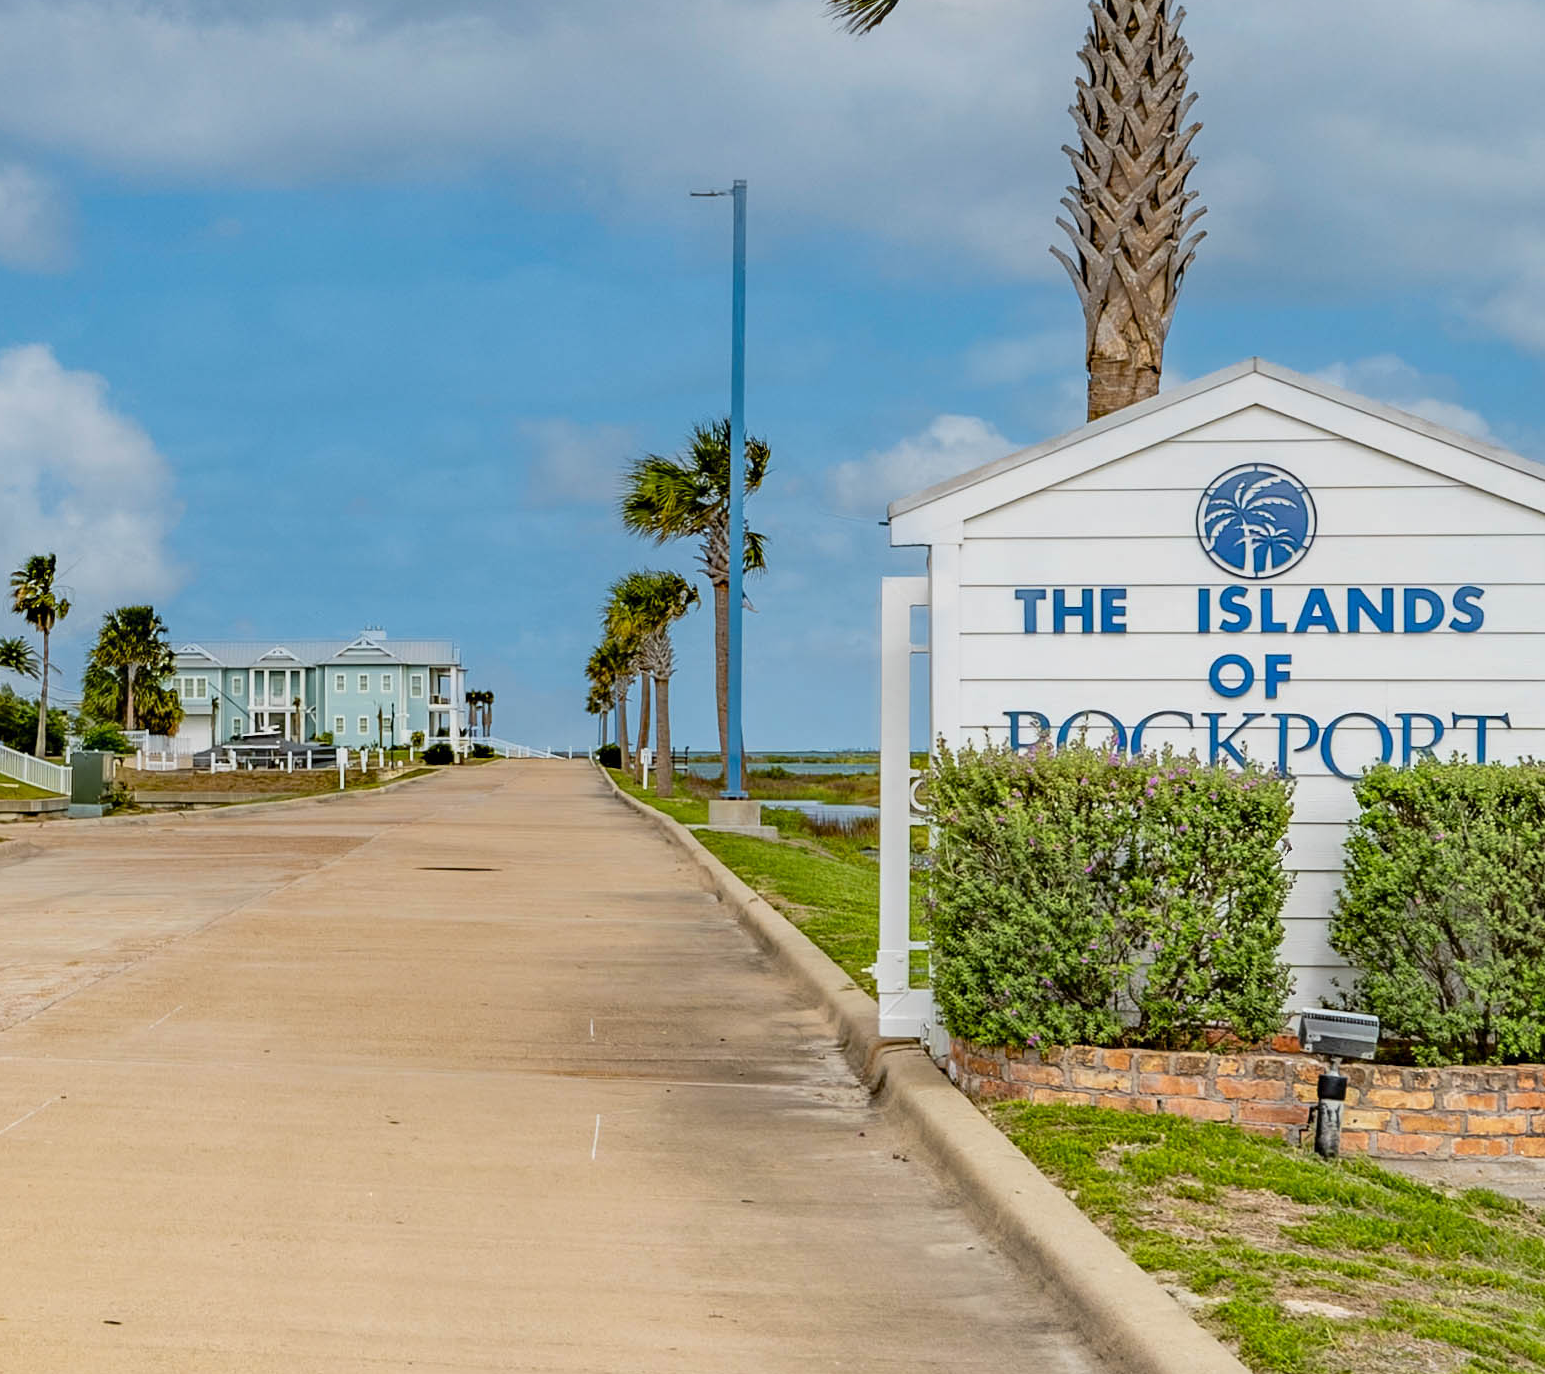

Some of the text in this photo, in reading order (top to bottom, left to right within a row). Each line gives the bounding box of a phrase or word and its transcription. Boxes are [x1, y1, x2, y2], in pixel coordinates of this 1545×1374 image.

[1014, 585, 1485, 634] THE ISLANDS
[1208, 654, 1292, 699] OF
